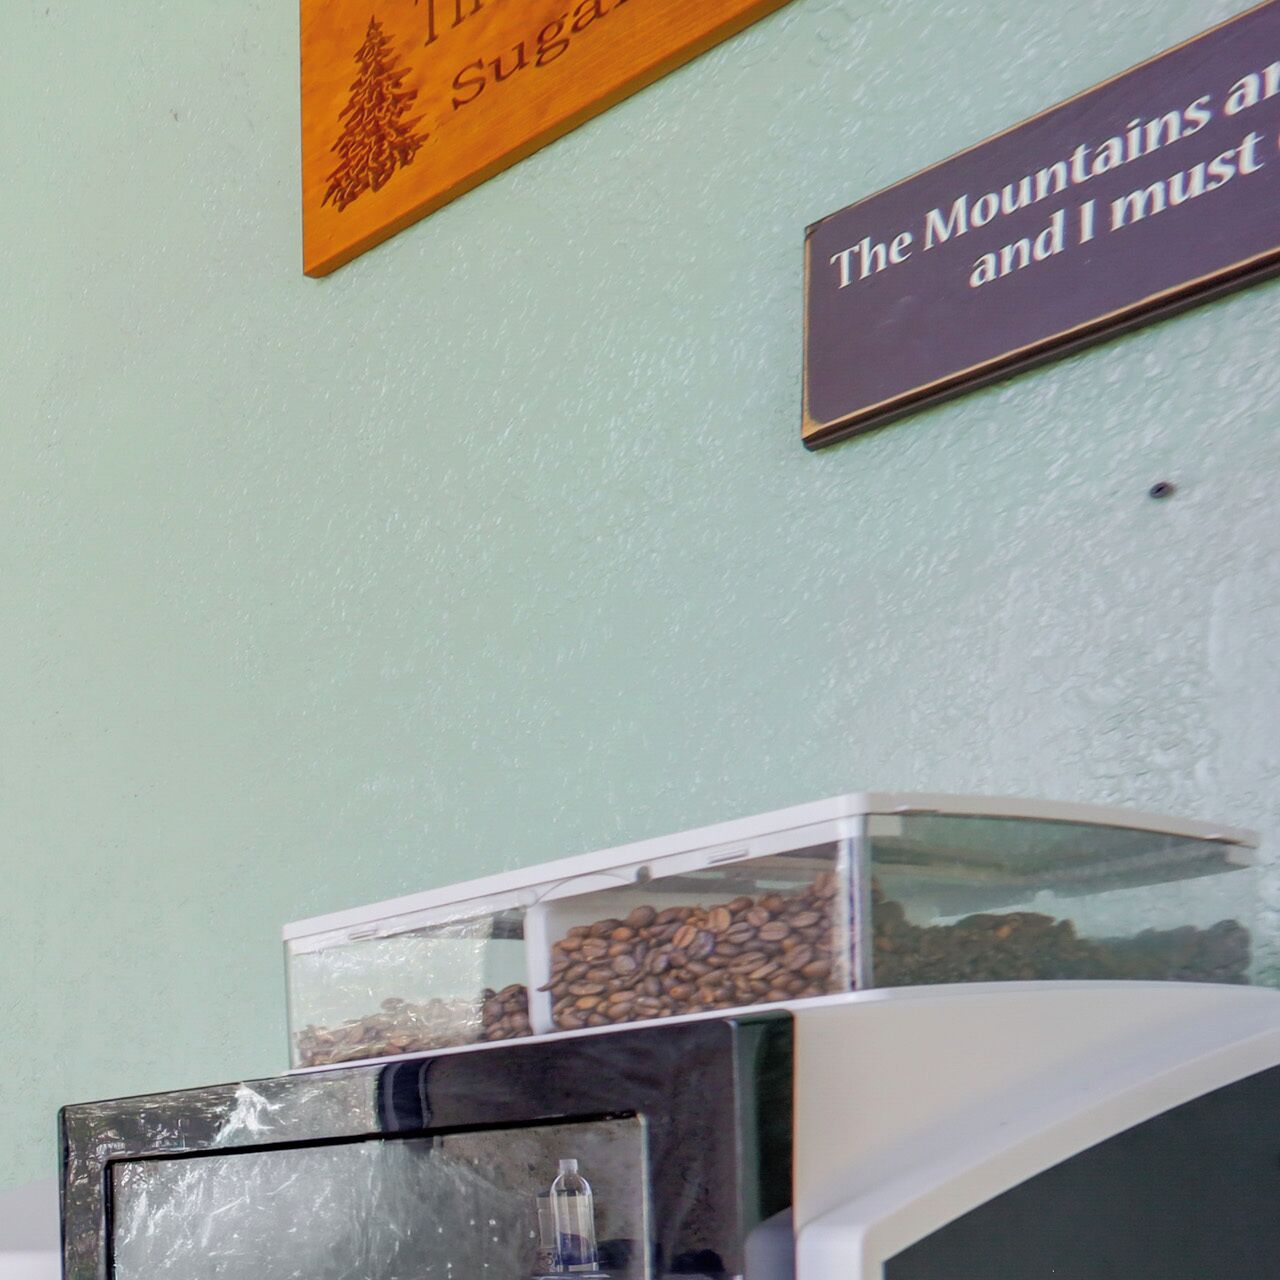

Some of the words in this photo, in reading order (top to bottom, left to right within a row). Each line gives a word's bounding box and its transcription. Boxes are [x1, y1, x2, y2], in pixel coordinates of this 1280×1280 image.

[451, 0, 629, 111] Suga
[829, 235, 913, 289] The
[922, 94, 1212, 252] Mountains
[968, 208, 1066, 288] and
[1078, 199, 1096, 245] I
[1109, 131, 1266, 232] must
